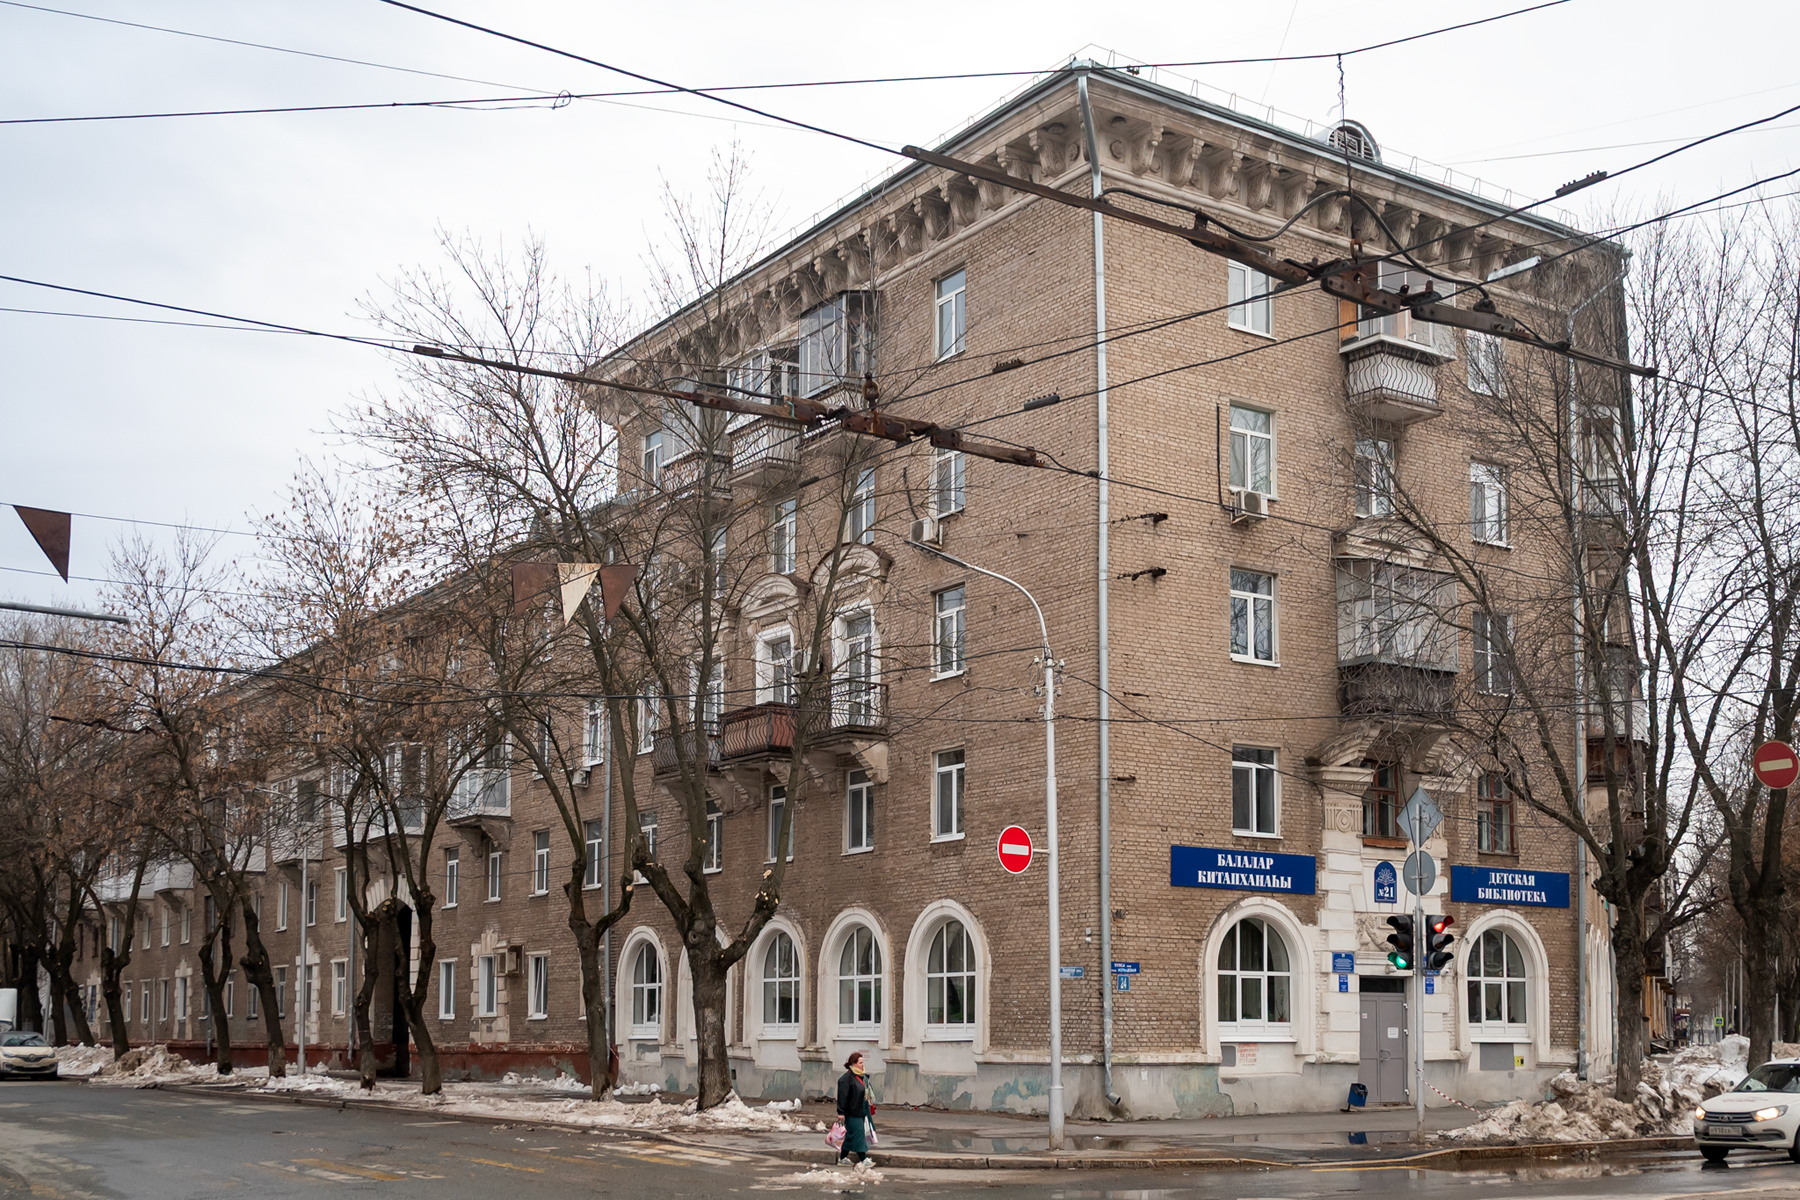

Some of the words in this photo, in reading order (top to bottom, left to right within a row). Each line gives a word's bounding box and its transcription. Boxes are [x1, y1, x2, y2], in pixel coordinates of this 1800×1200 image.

[1217, 853, 1274, 870] БАЛАЛАР
[1488, 872, 1535, 886] ДЕТСКАЯ
[1477, 887, 1547, 903] БИБЛИОТЕКА
